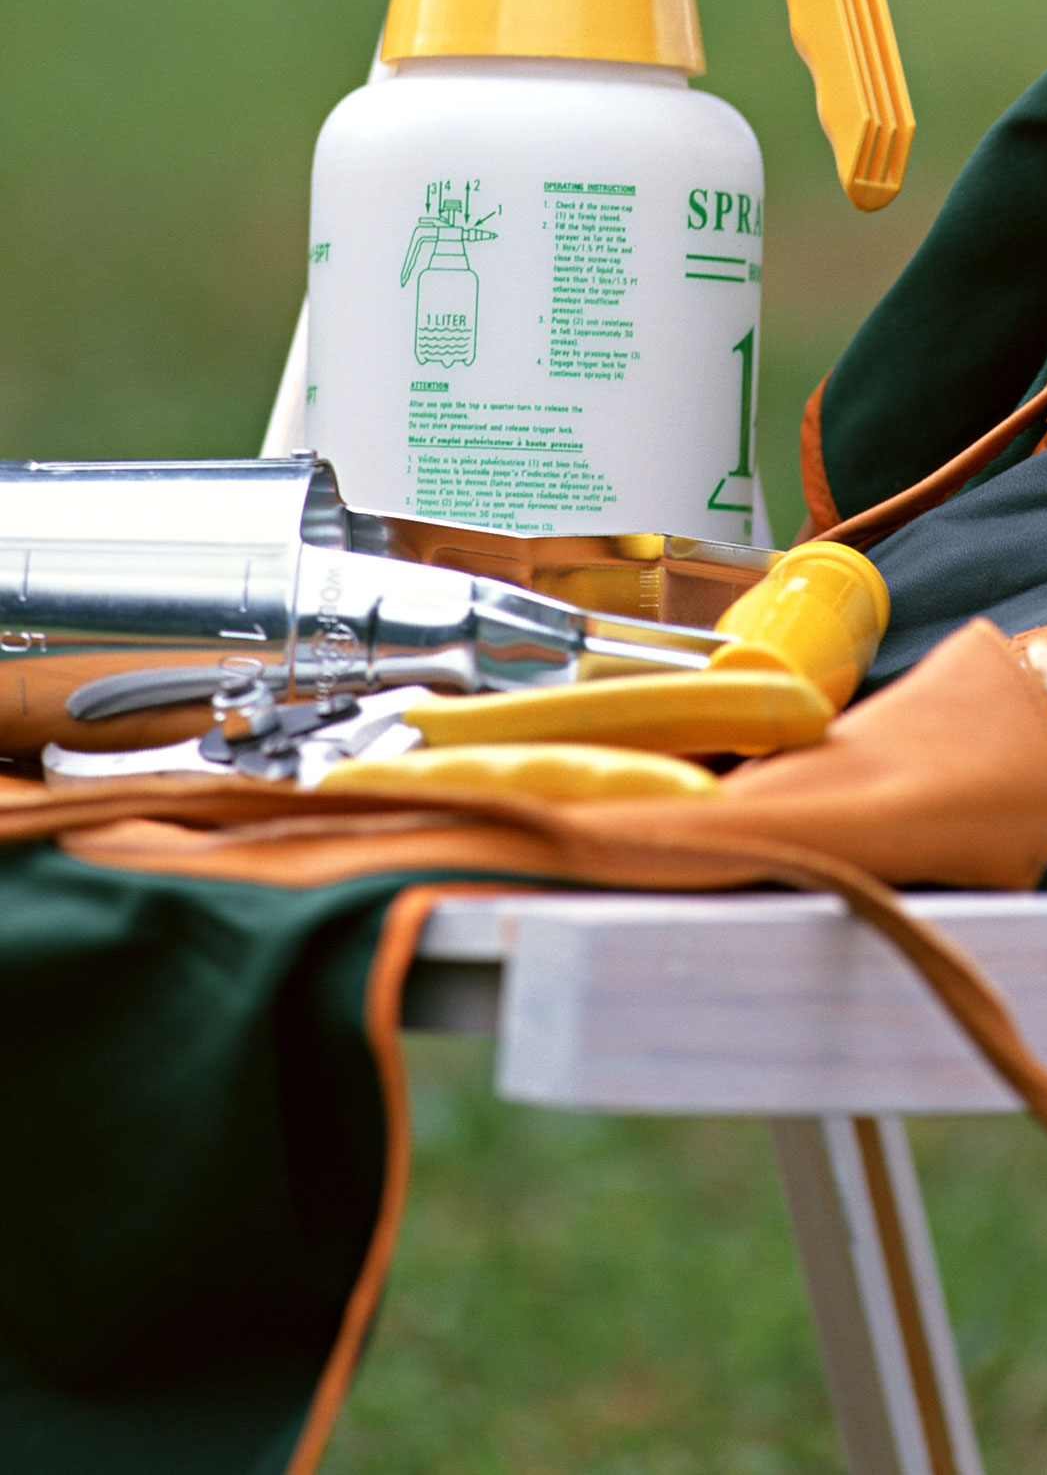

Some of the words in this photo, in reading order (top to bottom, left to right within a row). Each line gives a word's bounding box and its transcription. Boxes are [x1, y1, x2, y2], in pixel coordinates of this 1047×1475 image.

[431, 182, 437, 195] 3
[444, 180, 451, 191] 4
[474, 179, 480, 192] 2
[543, 182, 584, 192] OPERATING
[587, 184, 636, 194] INSTRUCTIONS
[498, 204, 502, 216] 1
[427, 314, 431, 326] 1
[435, 314, 466, 327] LITER
[410, 381, 449, 390] ATTENTION
